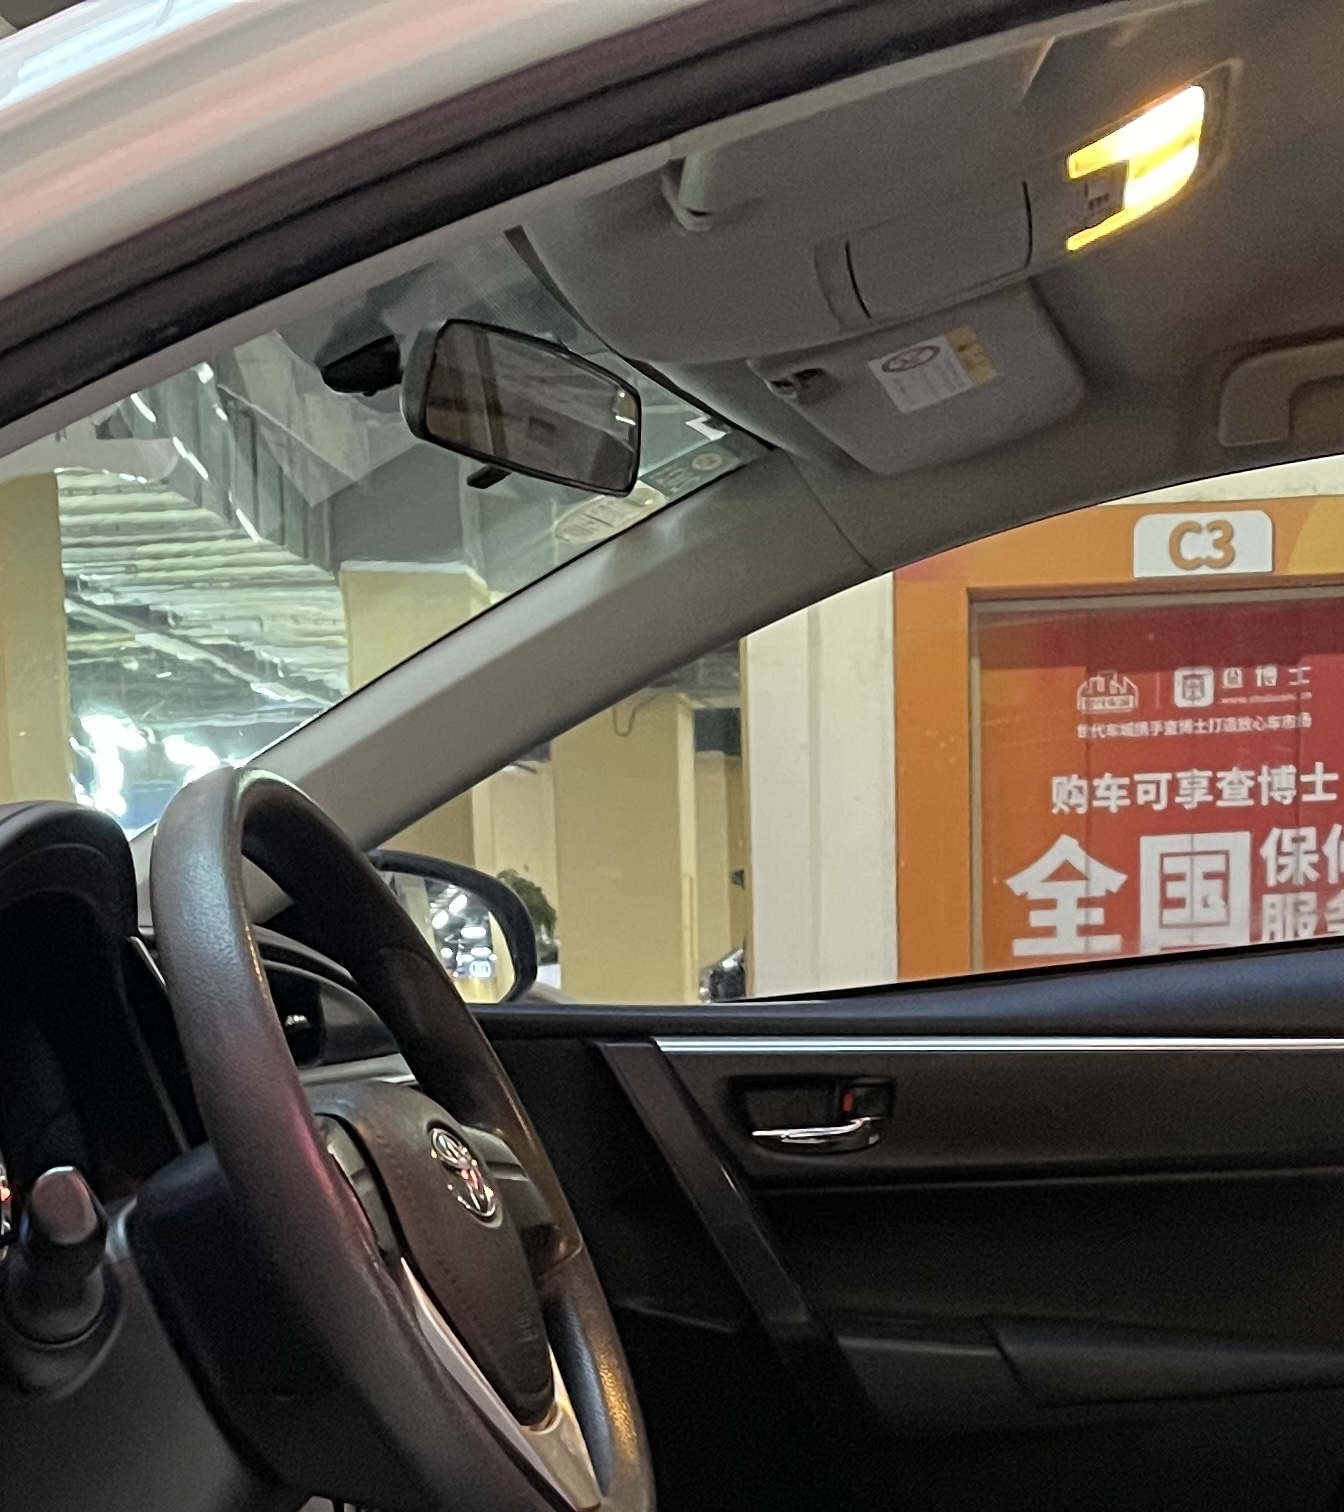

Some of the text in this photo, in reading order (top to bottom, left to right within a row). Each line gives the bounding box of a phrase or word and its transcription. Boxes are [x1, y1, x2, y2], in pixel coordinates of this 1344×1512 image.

[1168, 519, 1236, 571] C3
[1051, 762, 1339, 815] 购车可享查博士
[1005, 831, 1251, 956] 全国
